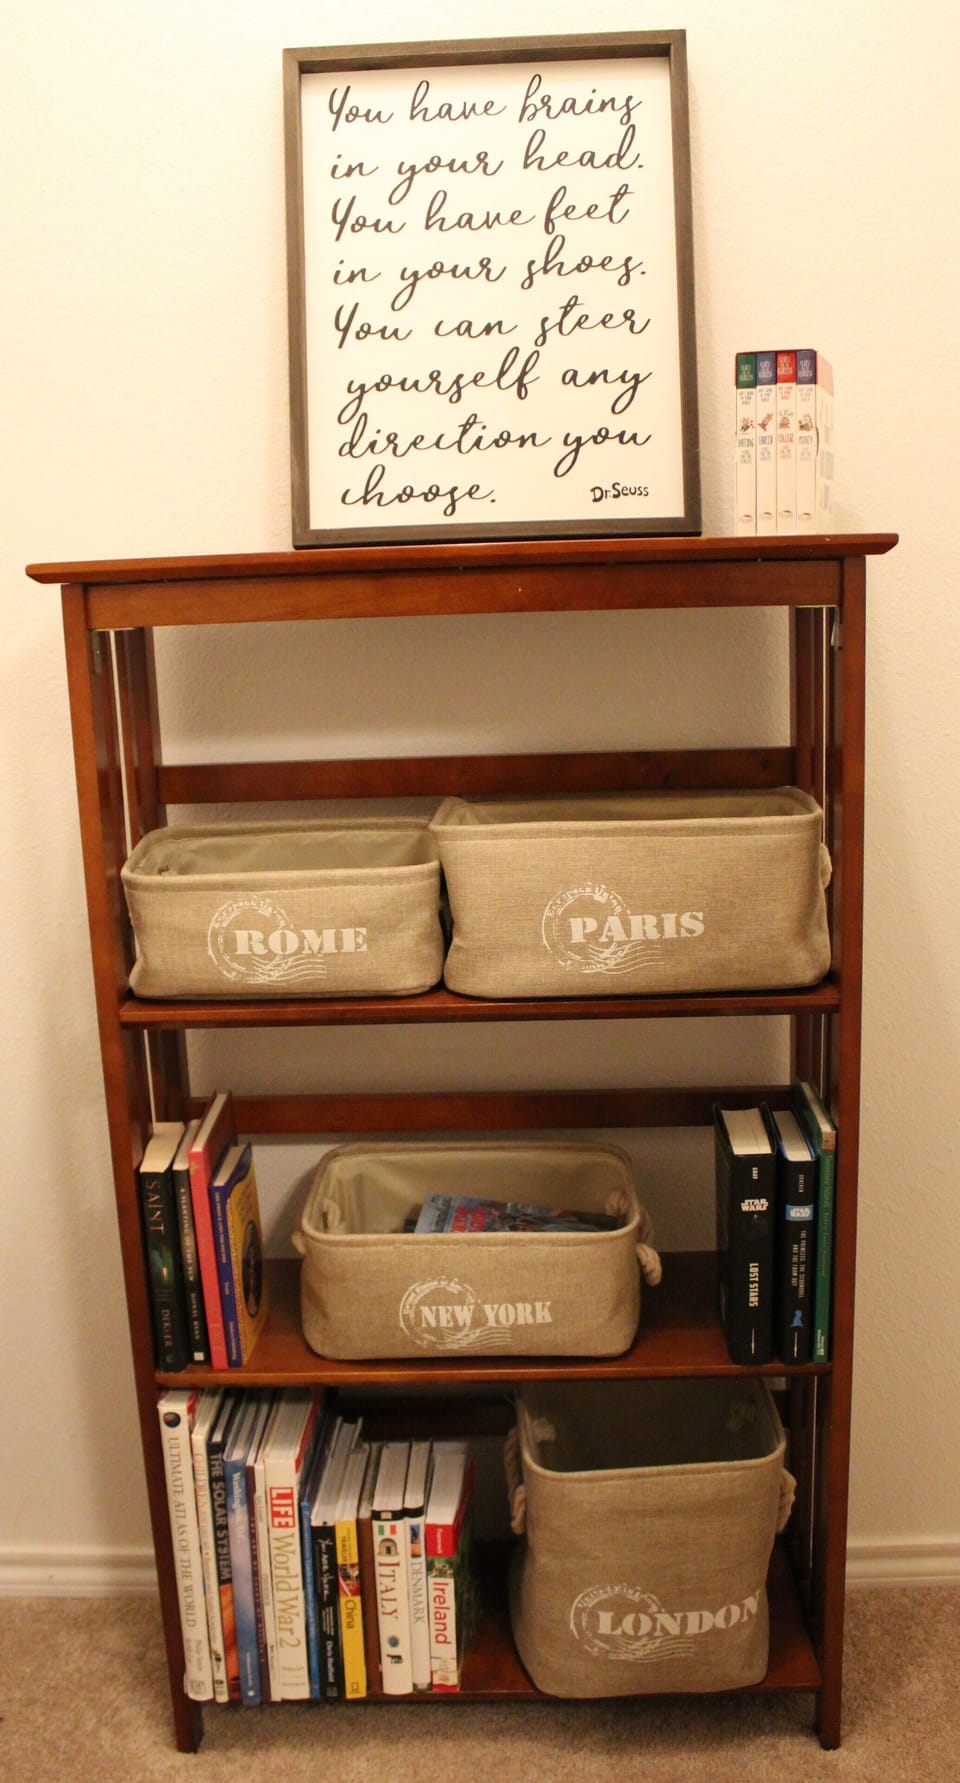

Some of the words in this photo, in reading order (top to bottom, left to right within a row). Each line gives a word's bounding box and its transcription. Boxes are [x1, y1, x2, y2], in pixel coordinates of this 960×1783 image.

[329, 85, 393, 131] You
[410, 80, 506, 122] have
[518, 74, 643, 126] brains
[330, 153, 379, 179] in
[388, 151, 504, 206] your
[523, 124, 644, 171] head.
[332, 196, 406, 242] You
[424, 190, 536, 232] have
[543, 184, 635, 235] feet
[334, 260, 381, 285] in
[391, 257, 506, 311] your
[521, 234, 646, 290] shoes.
[335, 302, 412, 349] You
[434, 316, 518, 338] can
[534, 295, 651, 347] steer
[337, 346, 541, 425] yourself
[561, 368, 652, 414] any
[339, 412, 552, 459] direction
[554, 426, 652, 477] you
[341, 464, 496, 516] choose.
[234, 927, 368, 955] ROME
[569, 911, 705, 943] PARIS
[145, 1179, 165, 1234] SAINT
[180, 1195, 190, 1234] SLANTING
[184, 1237, 191, 1246] OF
[185, 1249, 193, 1263] THE
[749, 1263, 760, 1283] LOST
[420, 1304, 474, 1328] NEW
[483, 1301, 552, 1327] YORK
[749, 1284, 760, 1307] STARS
[167, 1437, 185, 1496] ULTIMATE
[209, 1453, 223, 1477] THE
[174, 1501, 187, 1536] ATLAS
[212, 1481, 229, 1525] SOLAR
[270, 1488, 294, 1527] LIFE
[178, 1539, 190, 1555] OF
[216, 1530, 232, 1581] SYSTEM
[273, 1534, 299, 1594] World
[179, 1559, 193, 1580] THE
[378, 1561, 400, 1620] ITALY
[183, 1583, 197, 1628] WORLD
[344, 1599, 358, 1629] China
[410, 1562, 425, 1624] DENMARK
[433, 1582, 452, 1645] Ireland
[597, 1589, 760, 1636] LONDON
[279, 1595, 302, 1636] War
[279, 1636, 302, 1650] 2
